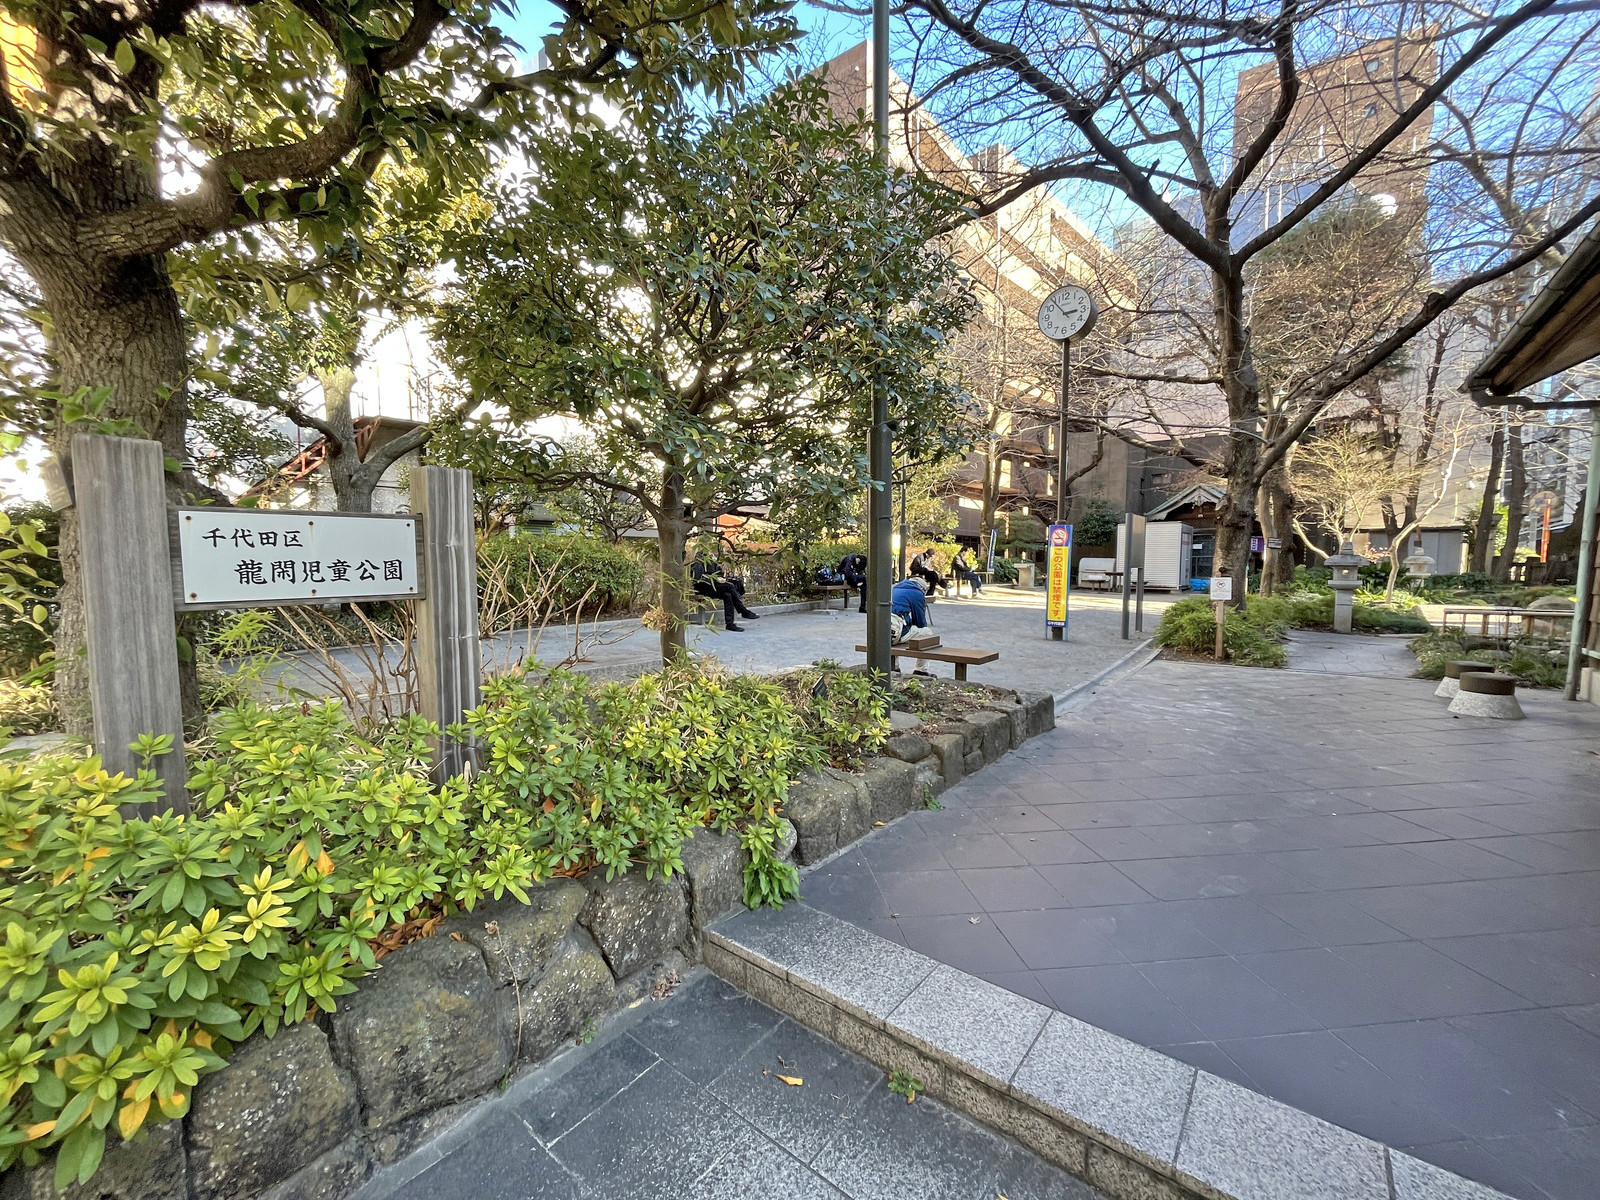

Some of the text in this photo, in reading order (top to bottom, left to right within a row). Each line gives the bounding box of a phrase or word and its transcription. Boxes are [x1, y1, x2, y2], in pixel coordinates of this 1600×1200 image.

[202, 527, 304, 549] 千代田区
[234, 559, 403, 585] 龍閑児童公園
